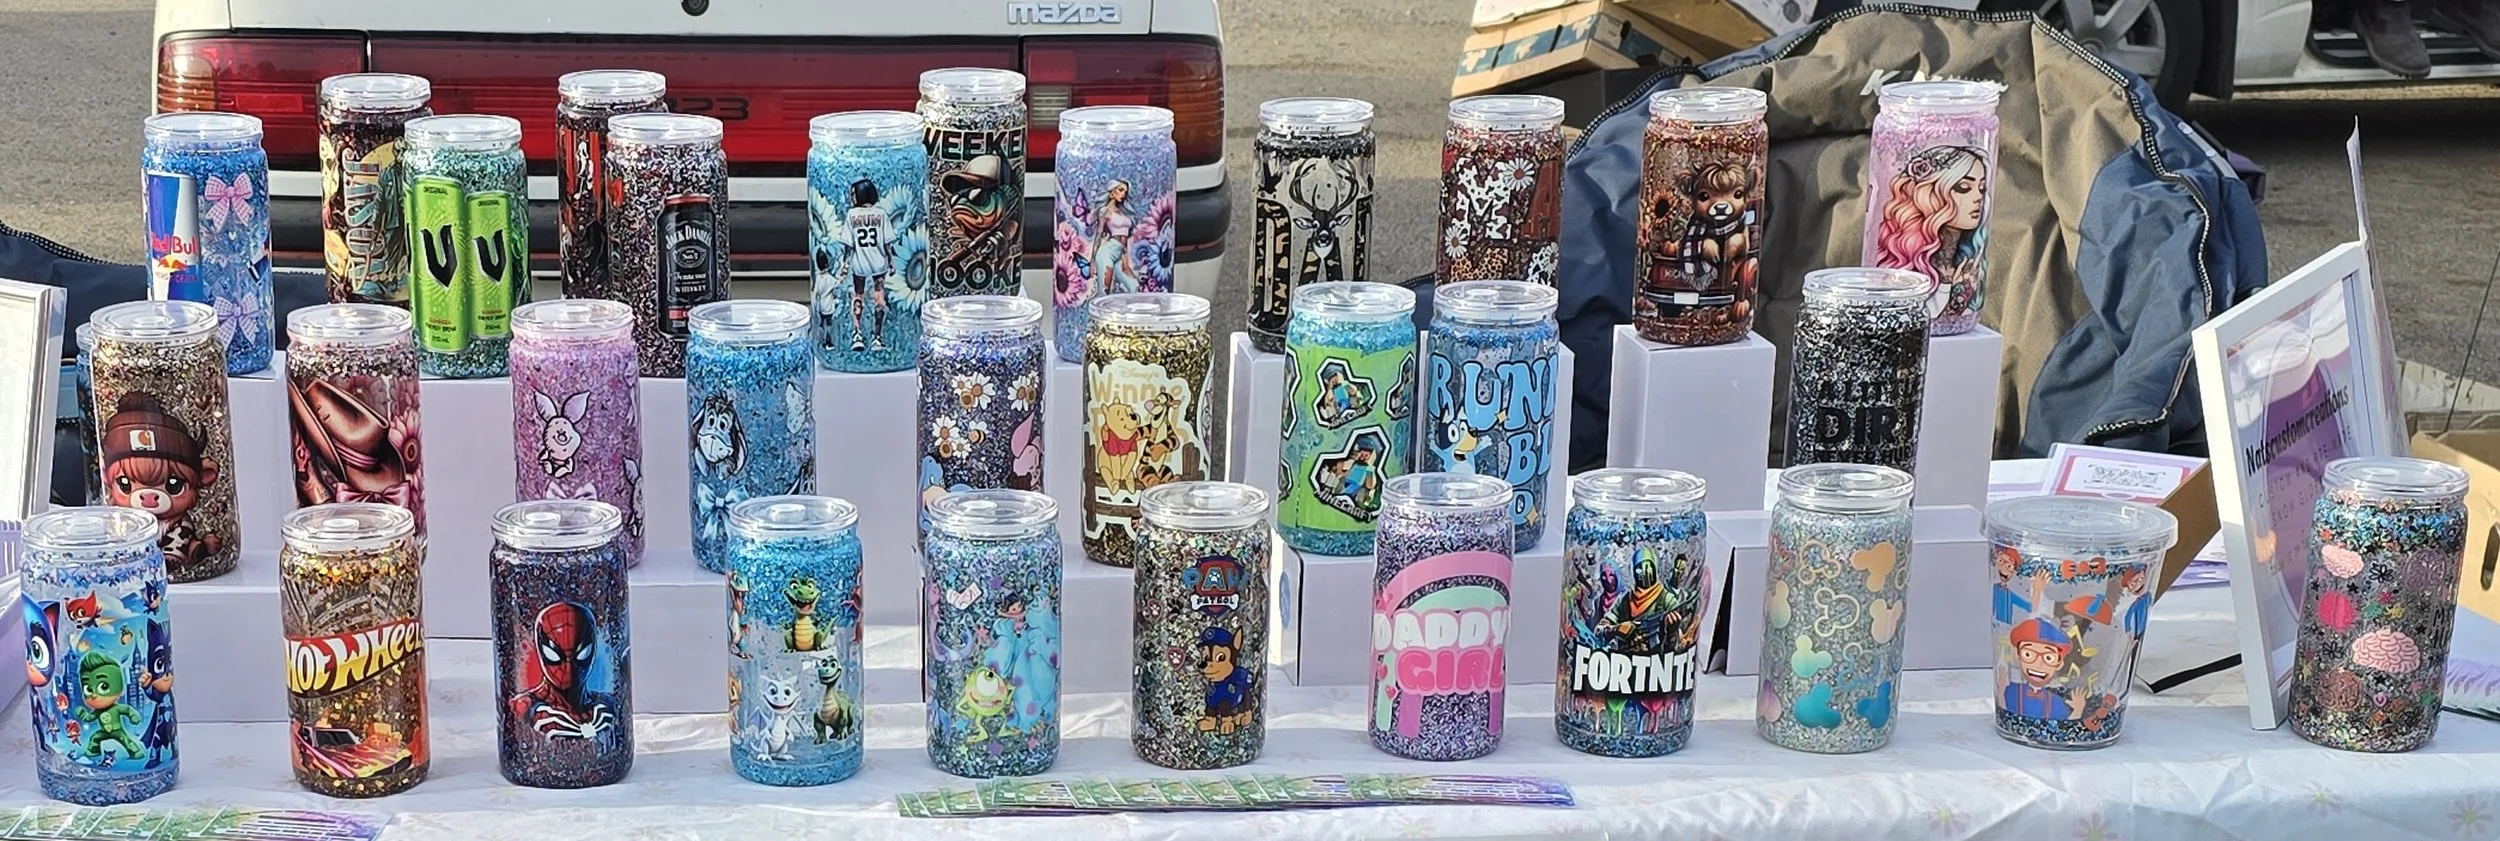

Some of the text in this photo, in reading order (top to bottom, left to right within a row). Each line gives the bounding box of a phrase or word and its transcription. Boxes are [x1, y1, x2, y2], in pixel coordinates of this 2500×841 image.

[172, 235, 199, 256] Bul
[857, 227, 877, 247] 23
[1092, 369, 1186, 405] Winne
[2245, 385, 2349, 477] Natscustomcreations
[1314, 486, 1374, 521] MINECRAFT
